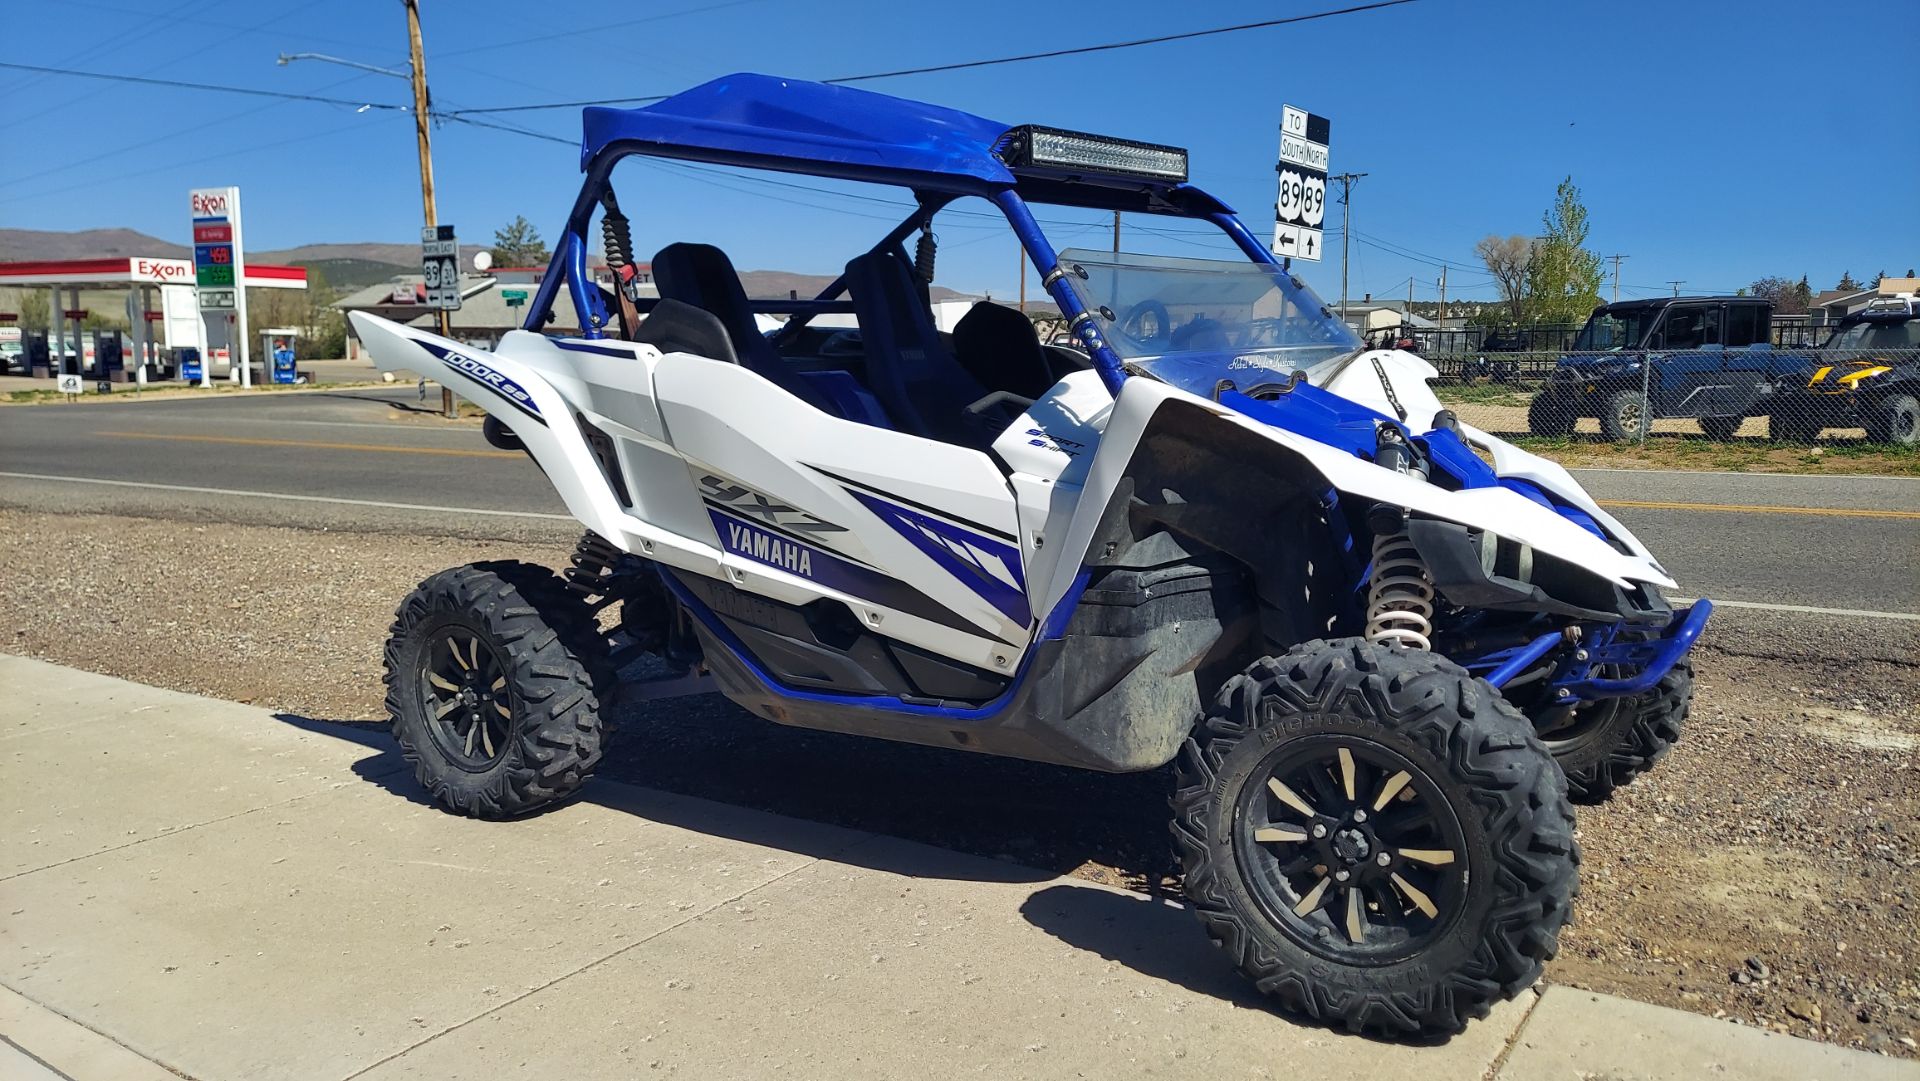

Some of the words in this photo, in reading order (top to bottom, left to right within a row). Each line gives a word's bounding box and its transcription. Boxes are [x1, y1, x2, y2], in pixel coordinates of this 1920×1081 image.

[1289, 113, 1301, 130] TO
[1281, 138, 1304, 161] SOUTH
[1306, 145, 1328, 167] NORTH
[192, 193, 227, 216] Exxon
[1280, 179, 1301, 209] 89
[1304, 186, 1323, 214] 89
[138, 260, 185, 280] Exxon
[425, 265, 439, 281] 89
[444, 268, 453, 280] 31
[443, 351, 506, 387] 1000R
[501, 384, 530, 401] SS
[1025, 428, 1085, 448] SPORT
[1028, 439, 1081, 457] SHIFT
[699, 474, 850, 543] YXZ
[728, 521, 812, 577] YAMAHA
